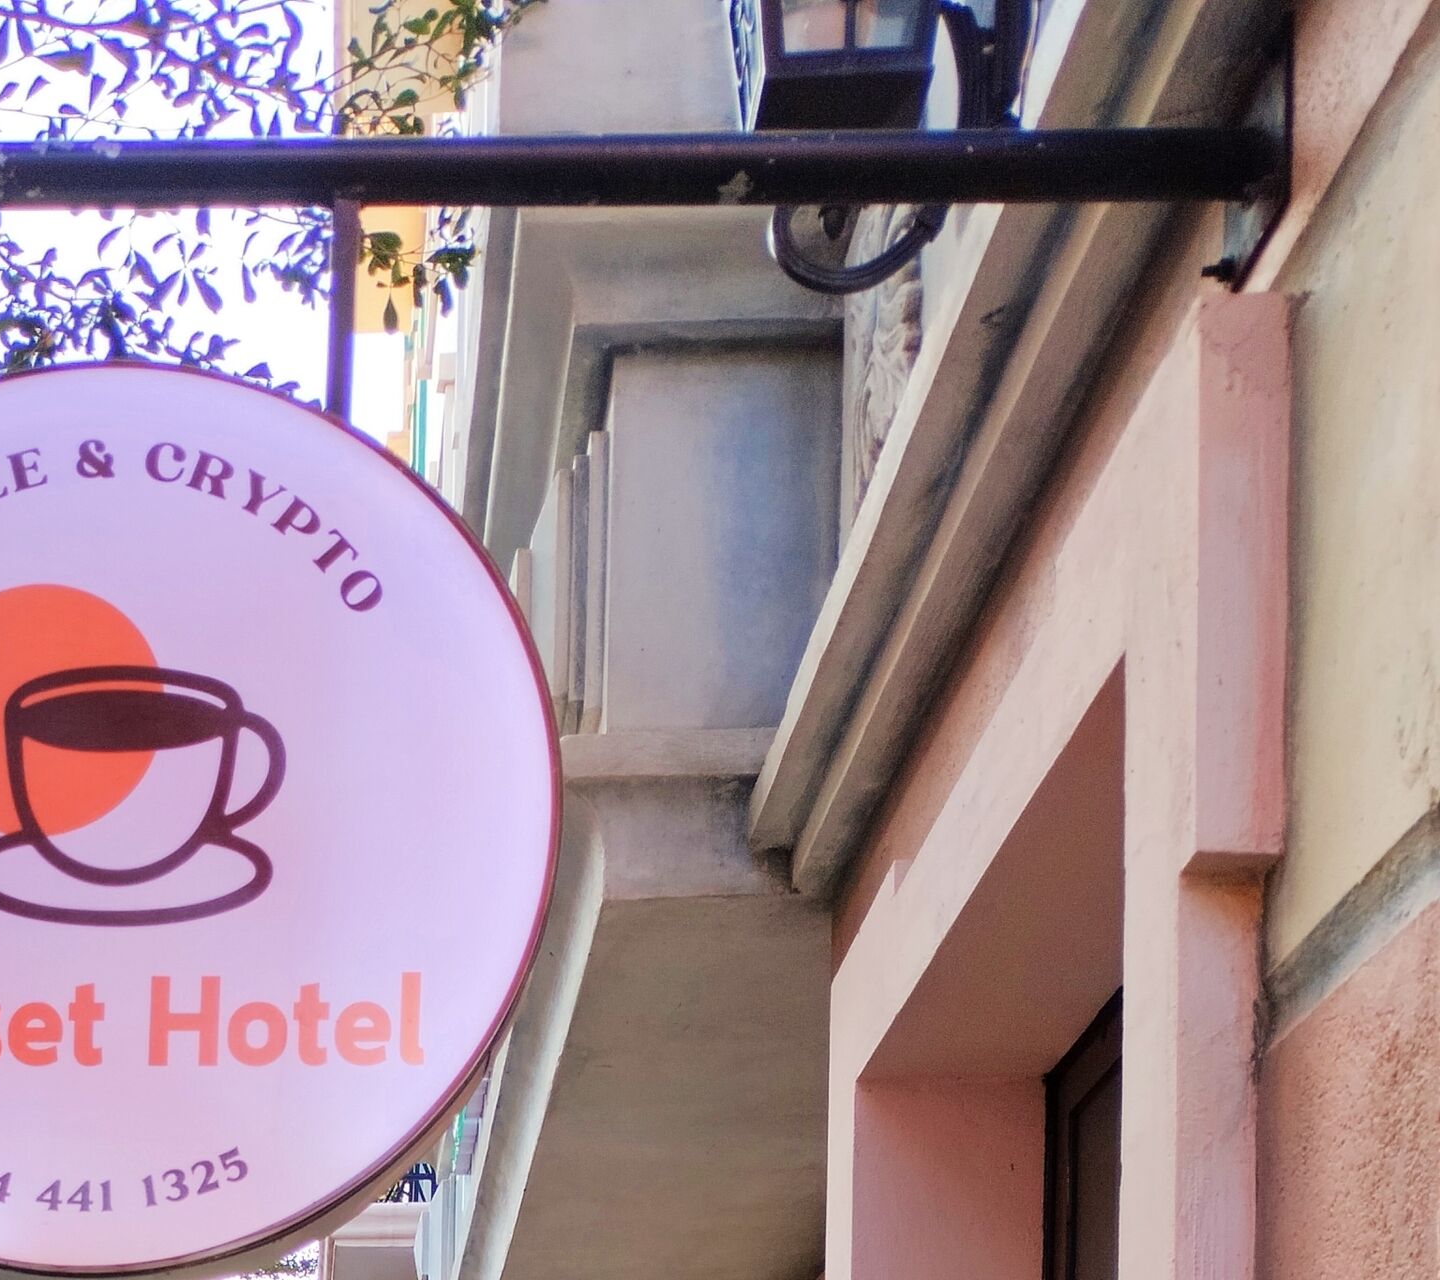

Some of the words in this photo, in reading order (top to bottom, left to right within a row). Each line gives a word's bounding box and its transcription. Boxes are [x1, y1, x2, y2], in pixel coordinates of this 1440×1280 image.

[75, 439, 115, 479] &
[145, 441, 384, 613] CRYPTO
[147, 971, 425, 1067] Hotel
[35, 1179, 112, 1212] 441
[142, 1146, 249, 1207] 1325
